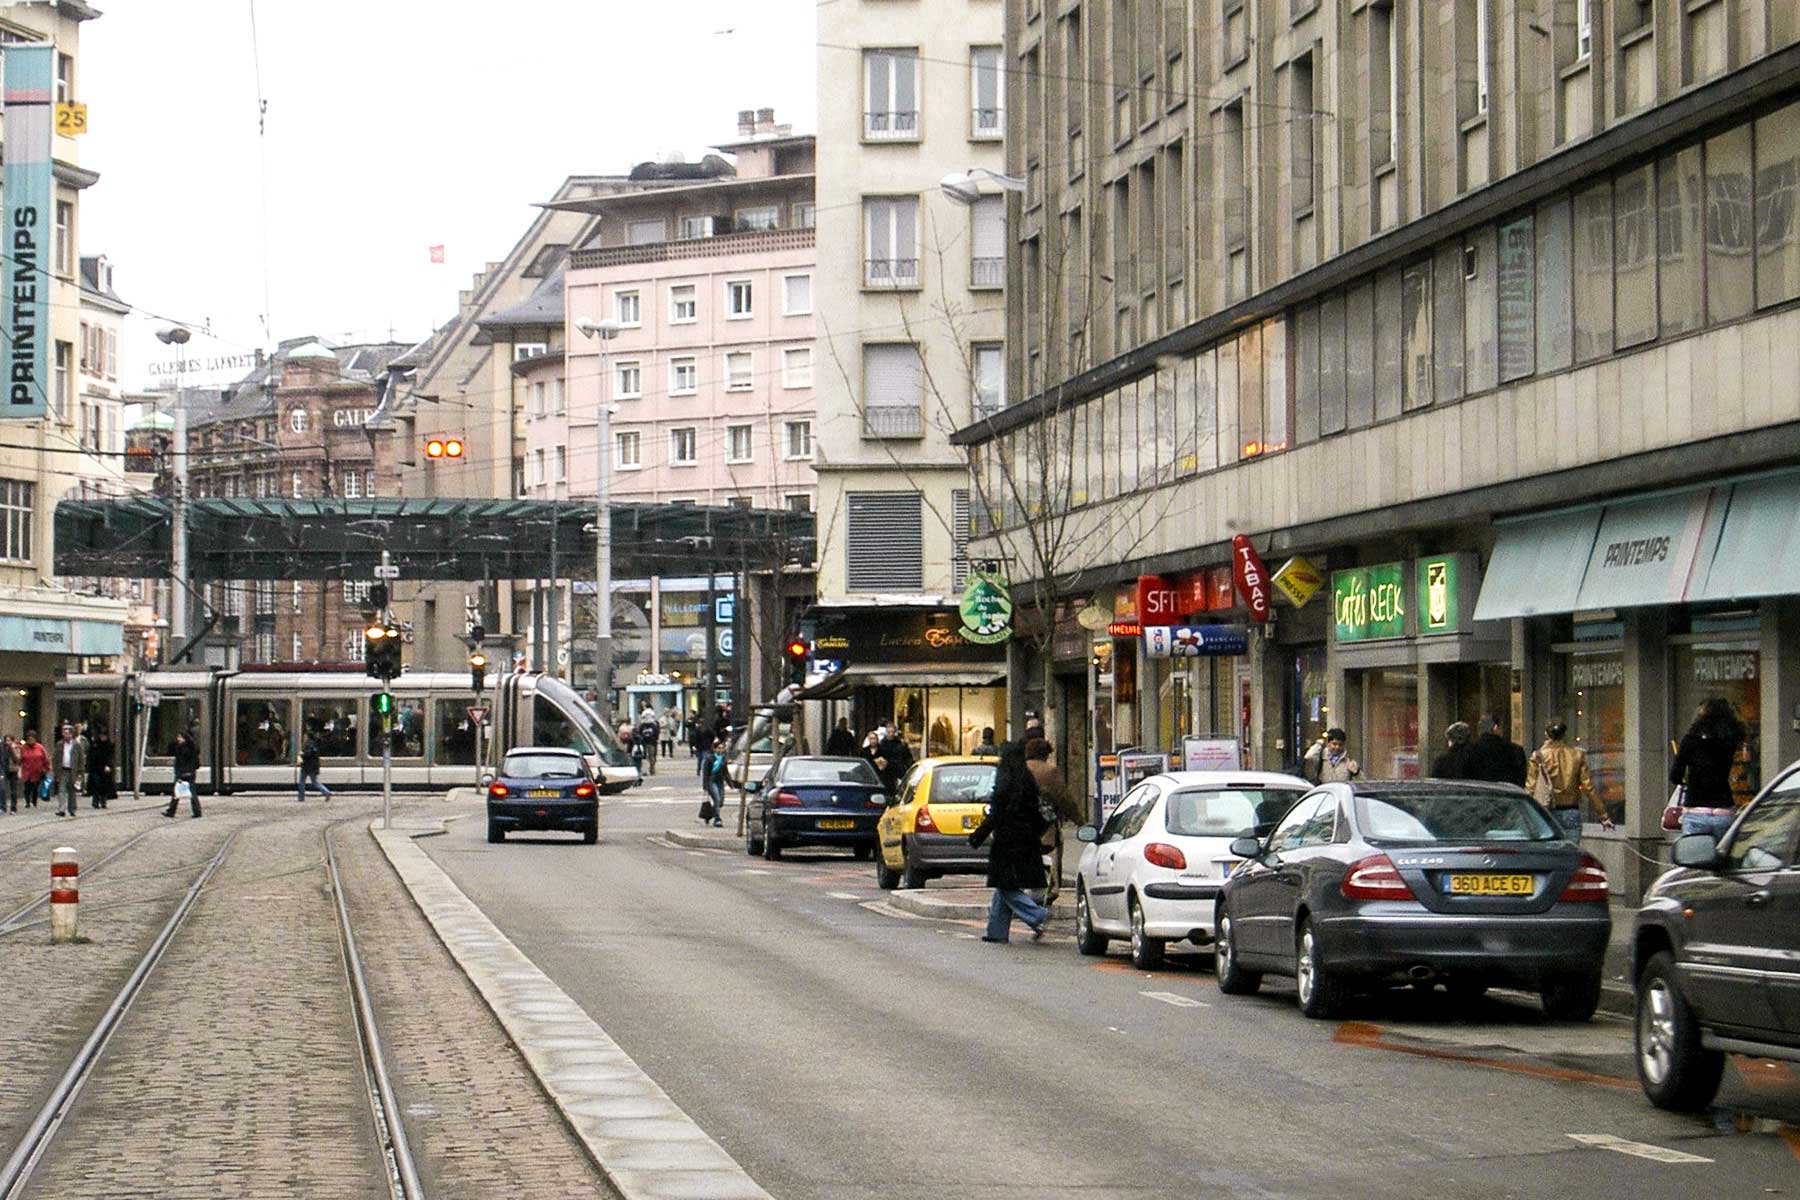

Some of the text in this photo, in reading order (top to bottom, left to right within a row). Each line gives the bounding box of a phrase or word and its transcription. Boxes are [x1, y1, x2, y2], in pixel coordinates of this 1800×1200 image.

[58, 110, 84, 128] 25
[10, 205, 37, 406] PRINTEMPS
[1603, 536, 1671, 569] PRINTEMPS
[1239, 547, 1265, 611] TABAC
[1279, 575, 1306, 602] PRESSE
[1335, 576, 1366, 633] Cafés
[1369, 583, 1404, 622] RECK
[1693, 654, 1756, 681] PRINTEMPS
[1453, 877, 1529, 891] 360 ACE 67
